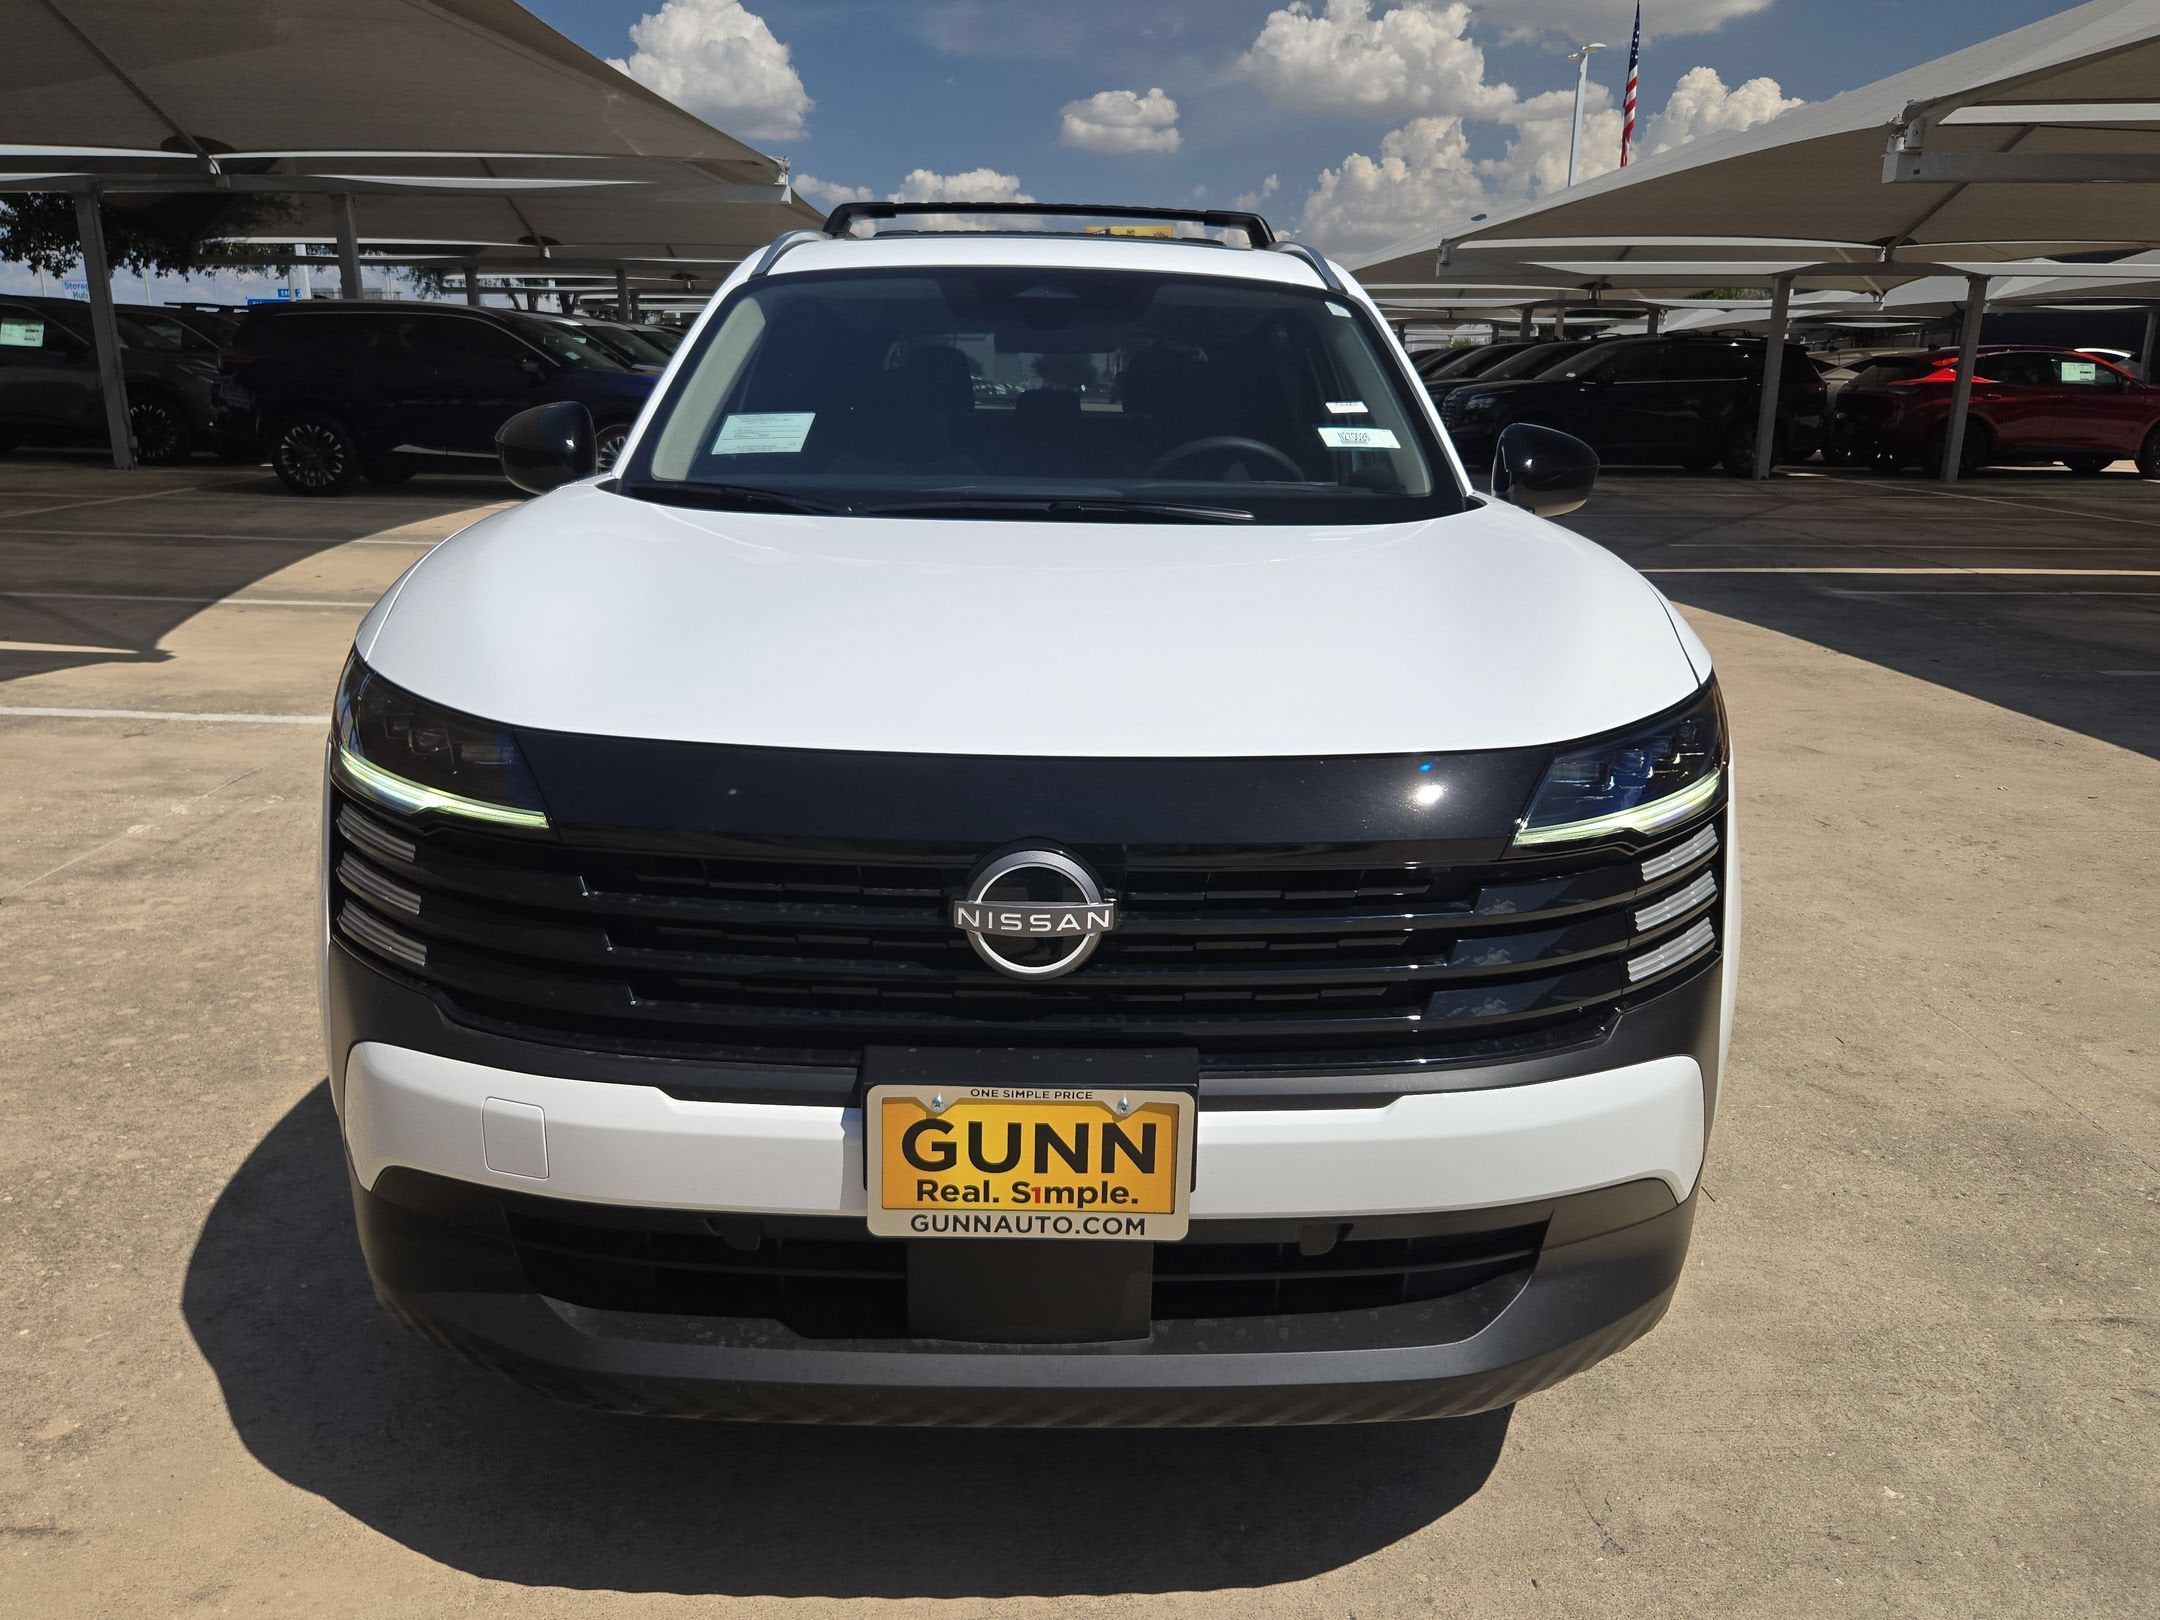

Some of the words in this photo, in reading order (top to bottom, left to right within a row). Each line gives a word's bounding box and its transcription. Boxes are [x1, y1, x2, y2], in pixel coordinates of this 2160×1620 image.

[957, 907, 1109, 932] NISSAN
[970, 1088, 998, 1098] ONE
[1003, 1089, 1050, 1099] SIMPLE
[1054, 1091, 1093, 1100] PRICE
[901, 1117, 1157, 1174] GUNN
[916, 1179, 1000, 1203] Real.
[910, 1214, 1146, 1236] GUNNAUTO.COM
